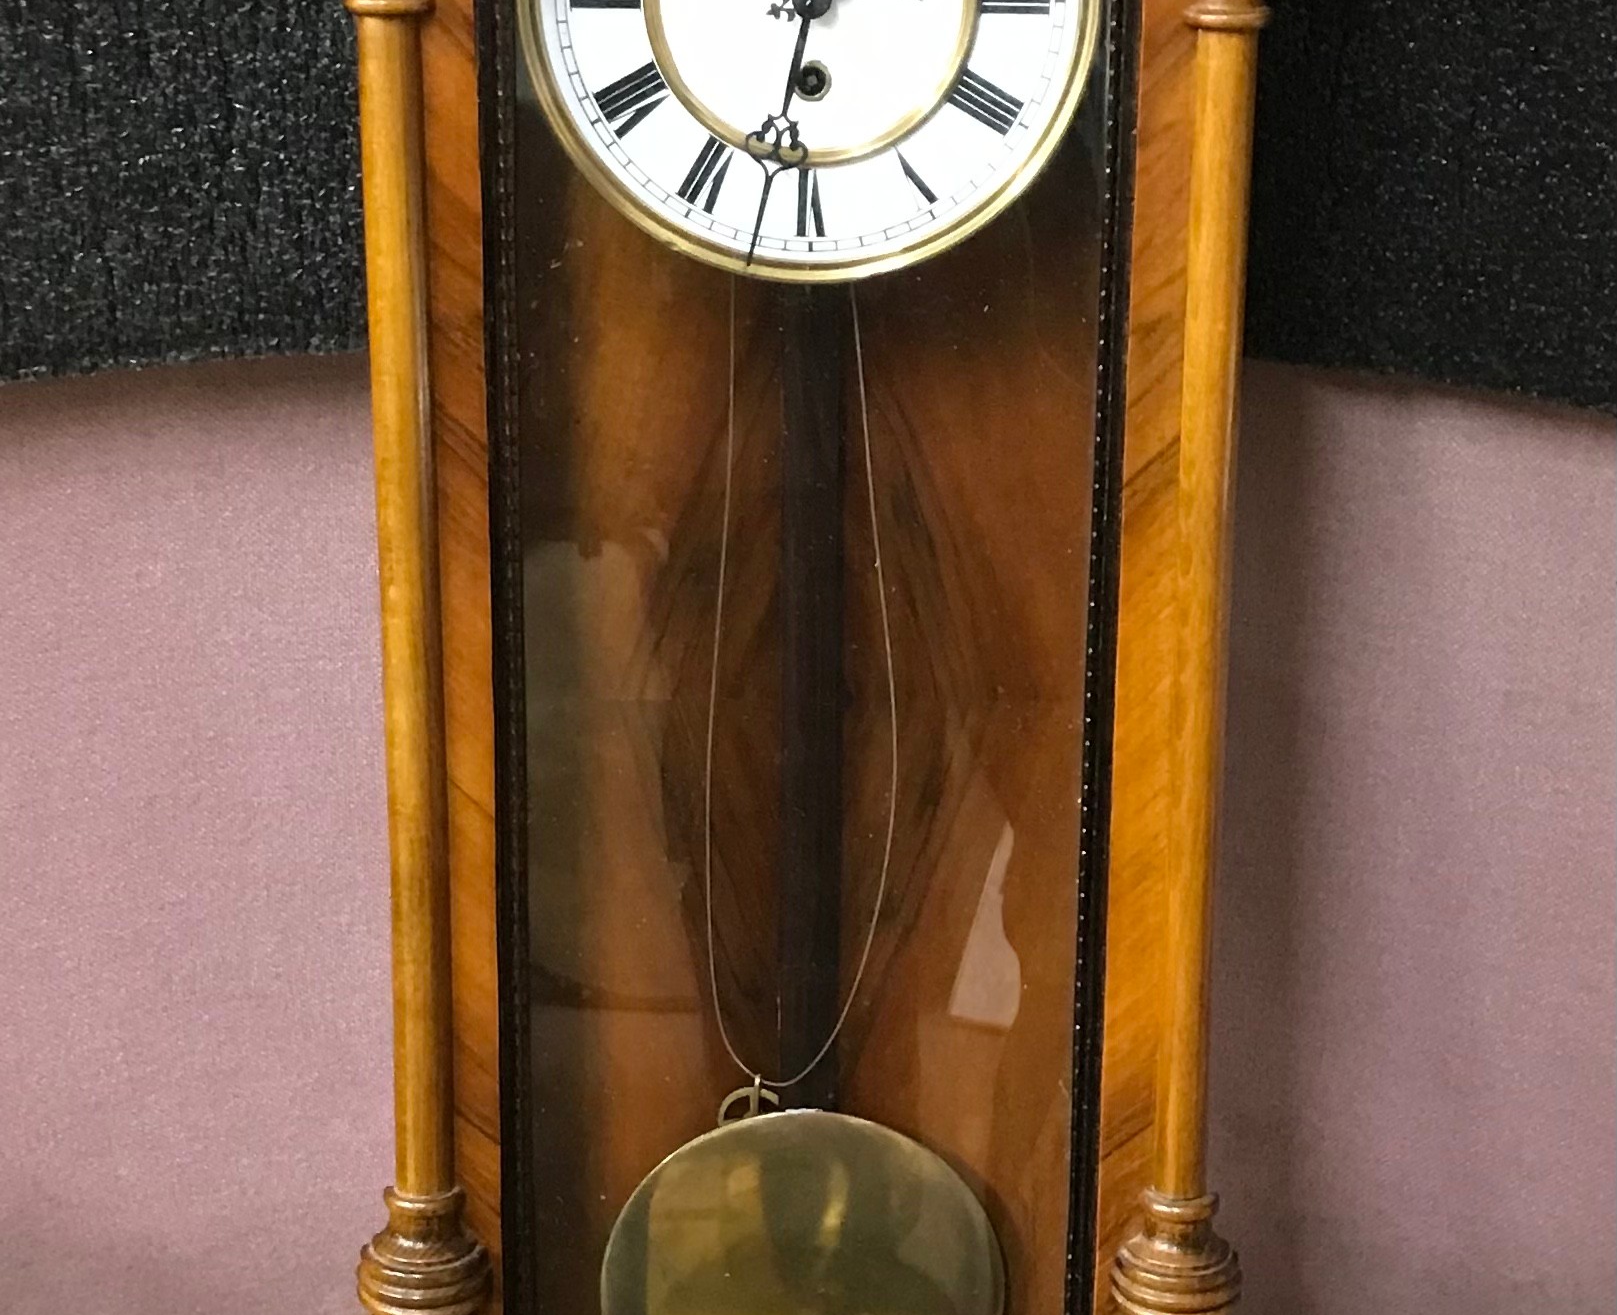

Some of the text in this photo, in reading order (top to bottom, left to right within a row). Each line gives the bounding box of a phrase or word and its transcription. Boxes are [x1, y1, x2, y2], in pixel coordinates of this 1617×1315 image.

[593, 62, 670, 137] VIII
[677, 134, 733, 213] VII
[795, 168, 825, 237] VI
[897, 146, 937, 211] V
